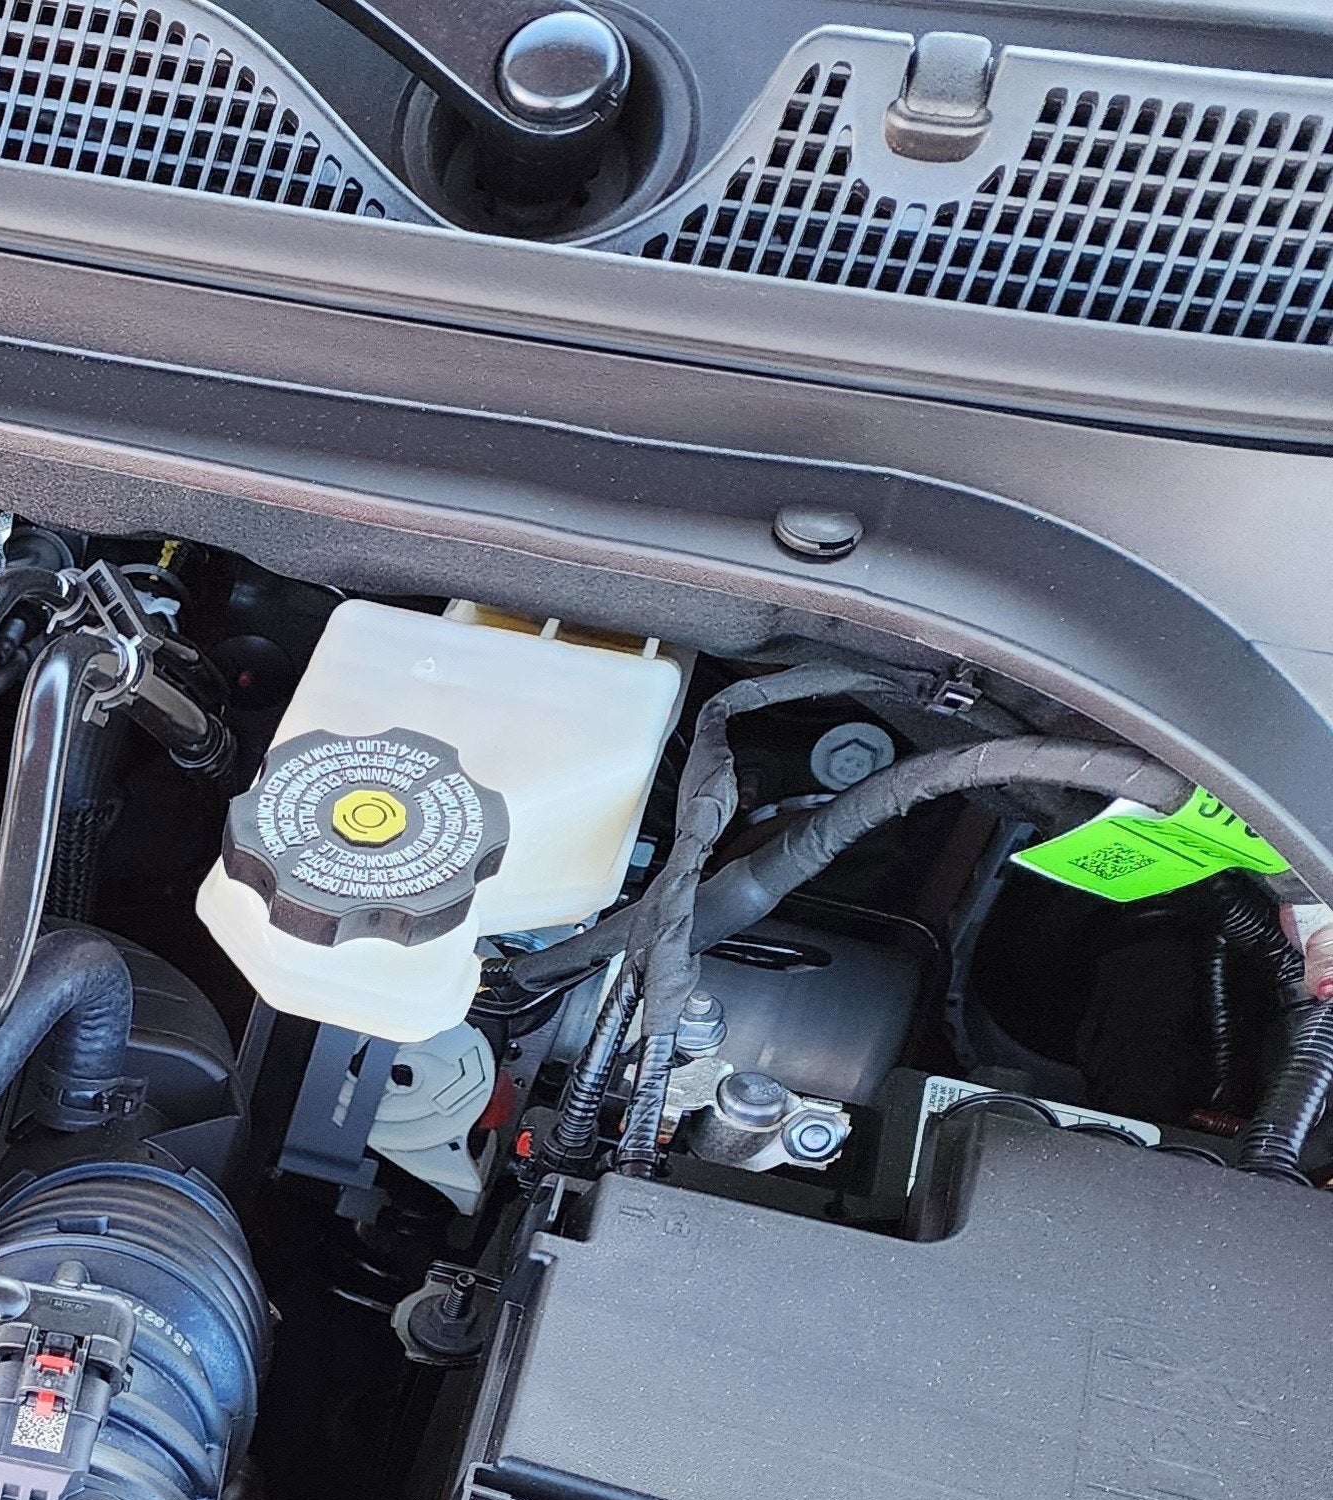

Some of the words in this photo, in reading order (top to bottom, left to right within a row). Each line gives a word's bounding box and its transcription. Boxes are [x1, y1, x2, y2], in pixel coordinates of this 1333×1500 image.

[306, 739, 353, 762] FROM
[354, 739, 399, 754] FLUID
[404, 746, 442, 769] DOT
[297, 751, 316, 765] A
[337, 752, 398, 769] BEFORE
[393, 758, 430, 780] CAP
[261, 756, 307, 795] SEALED
[301, 773, 343, 803] CLEAN
[298, 802, 321, 842] FILLER
[412, 788, 441, 844] PROVENANT
[277, 819, 305, 849] ONLY
[434, 832, 460, 853] QUE
[446, 821, 484, 867] NETTOYER
[303, 852, 335, 873] DOT
[365, 850, 406, 868] BIDON
[385, 855, 435, 882] LIQUIDE
[435, 861, 459, 878] LE
[327, 863, 368, 882] FREIN
[369, 869, 389, 883] DE
[384, 868, 446, 898] BOUCHON
[338, 881, 385, 897] AVANT
